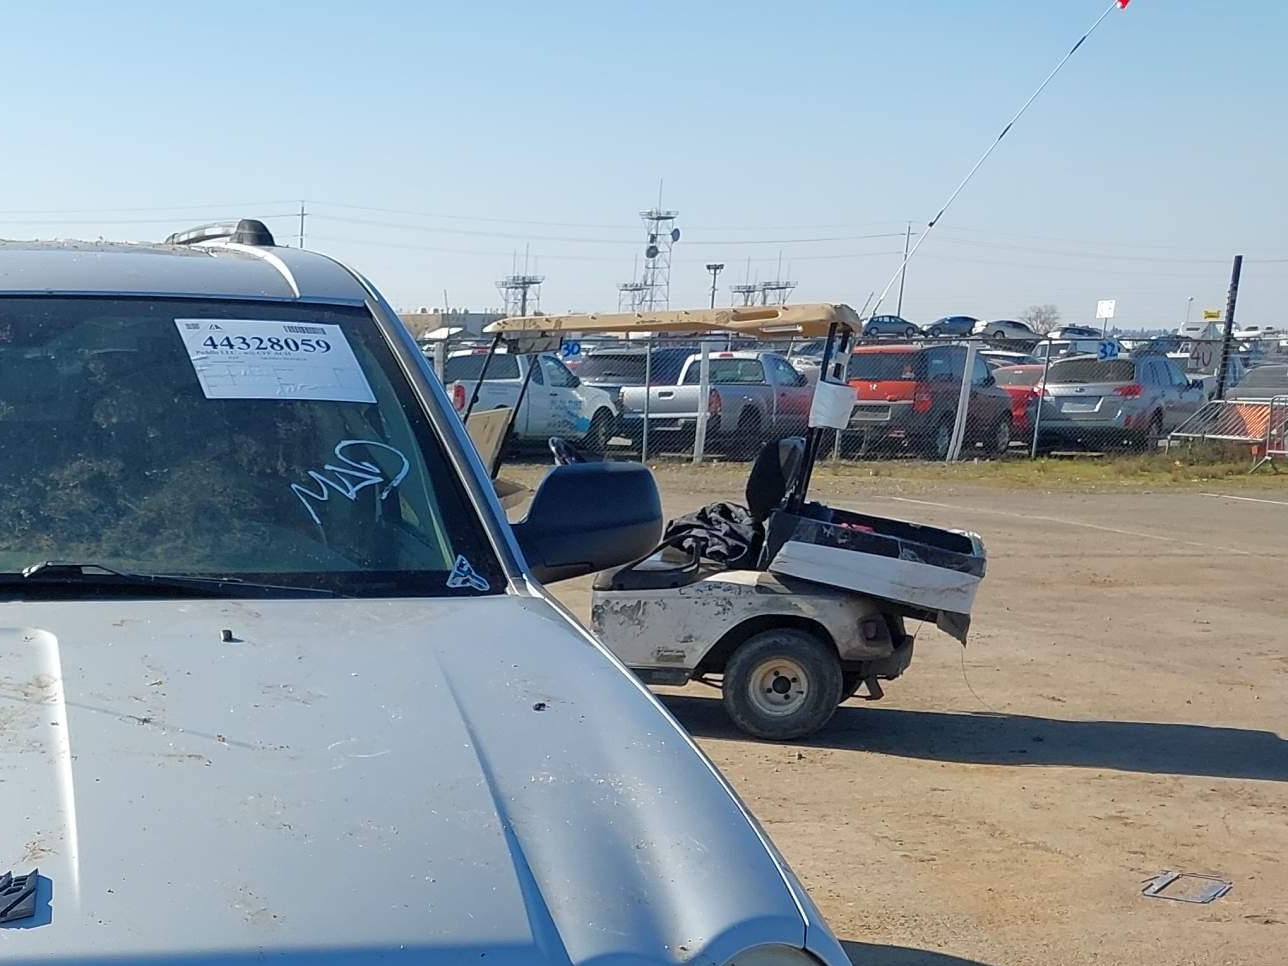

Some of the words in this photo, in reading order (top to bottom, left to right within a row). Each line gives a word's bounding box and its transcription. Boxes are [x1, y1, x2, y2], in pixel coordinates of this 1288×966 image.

[202, 335, 332, 354] 44328059
[562, 342, 581, 357] 30
[1098, 341, 1118, 360] 32
